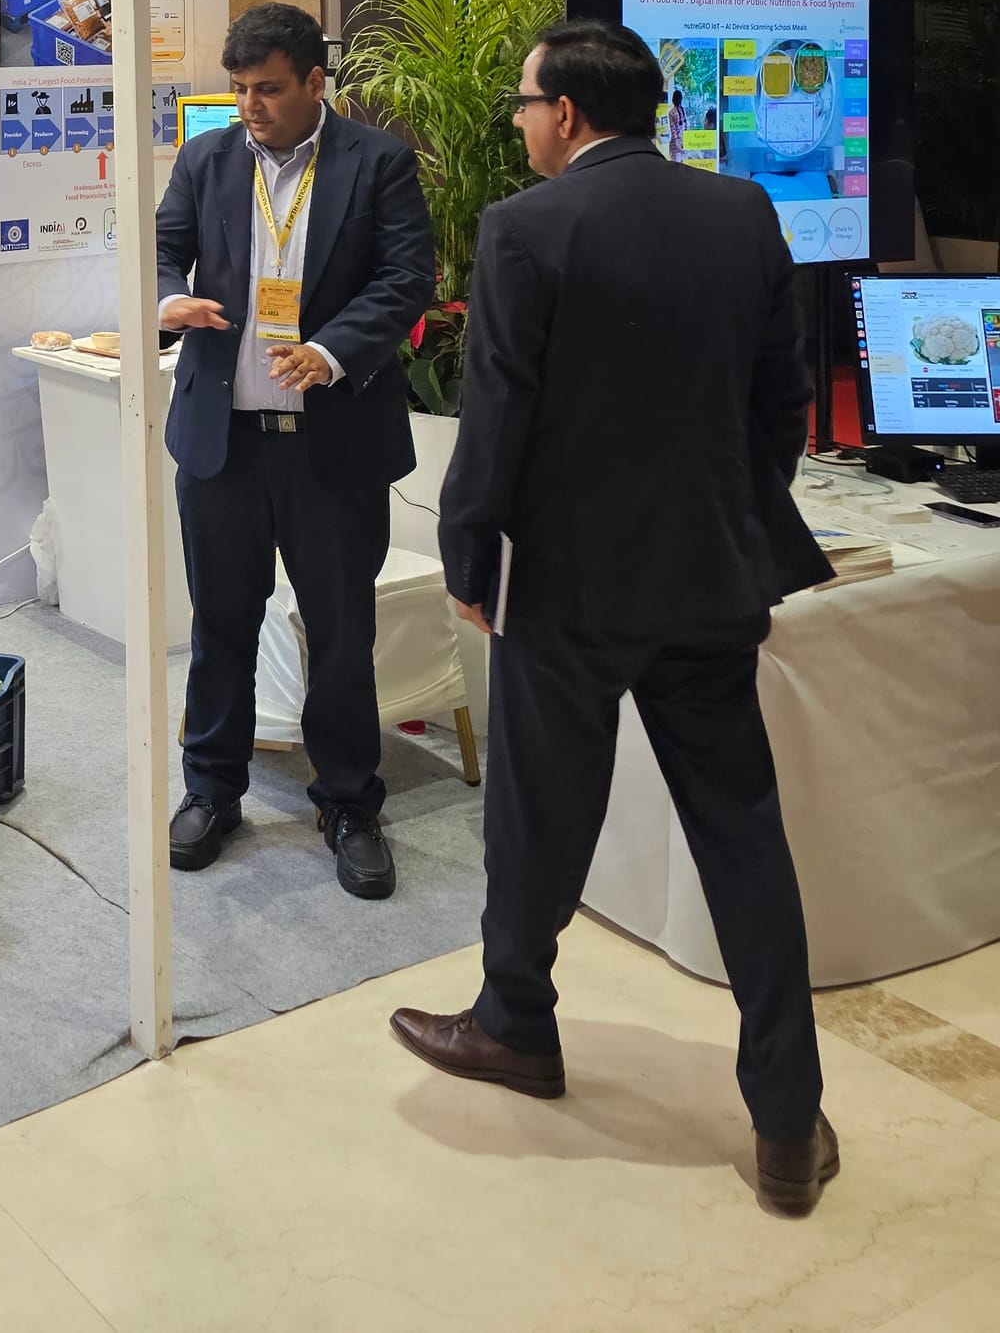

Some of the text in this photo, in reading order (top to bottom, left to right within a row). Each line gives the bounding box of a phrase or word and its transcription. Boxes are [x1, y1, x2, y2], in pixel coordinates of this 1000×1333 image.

[827, 0, 855, 9] Systems
[750, 23, 773, 32] Scanning
[11, 78, 27, 86] India
[38, 77, 59, 86] Largest
[289, 178, 310, 224] FIFTH NATIONAL
